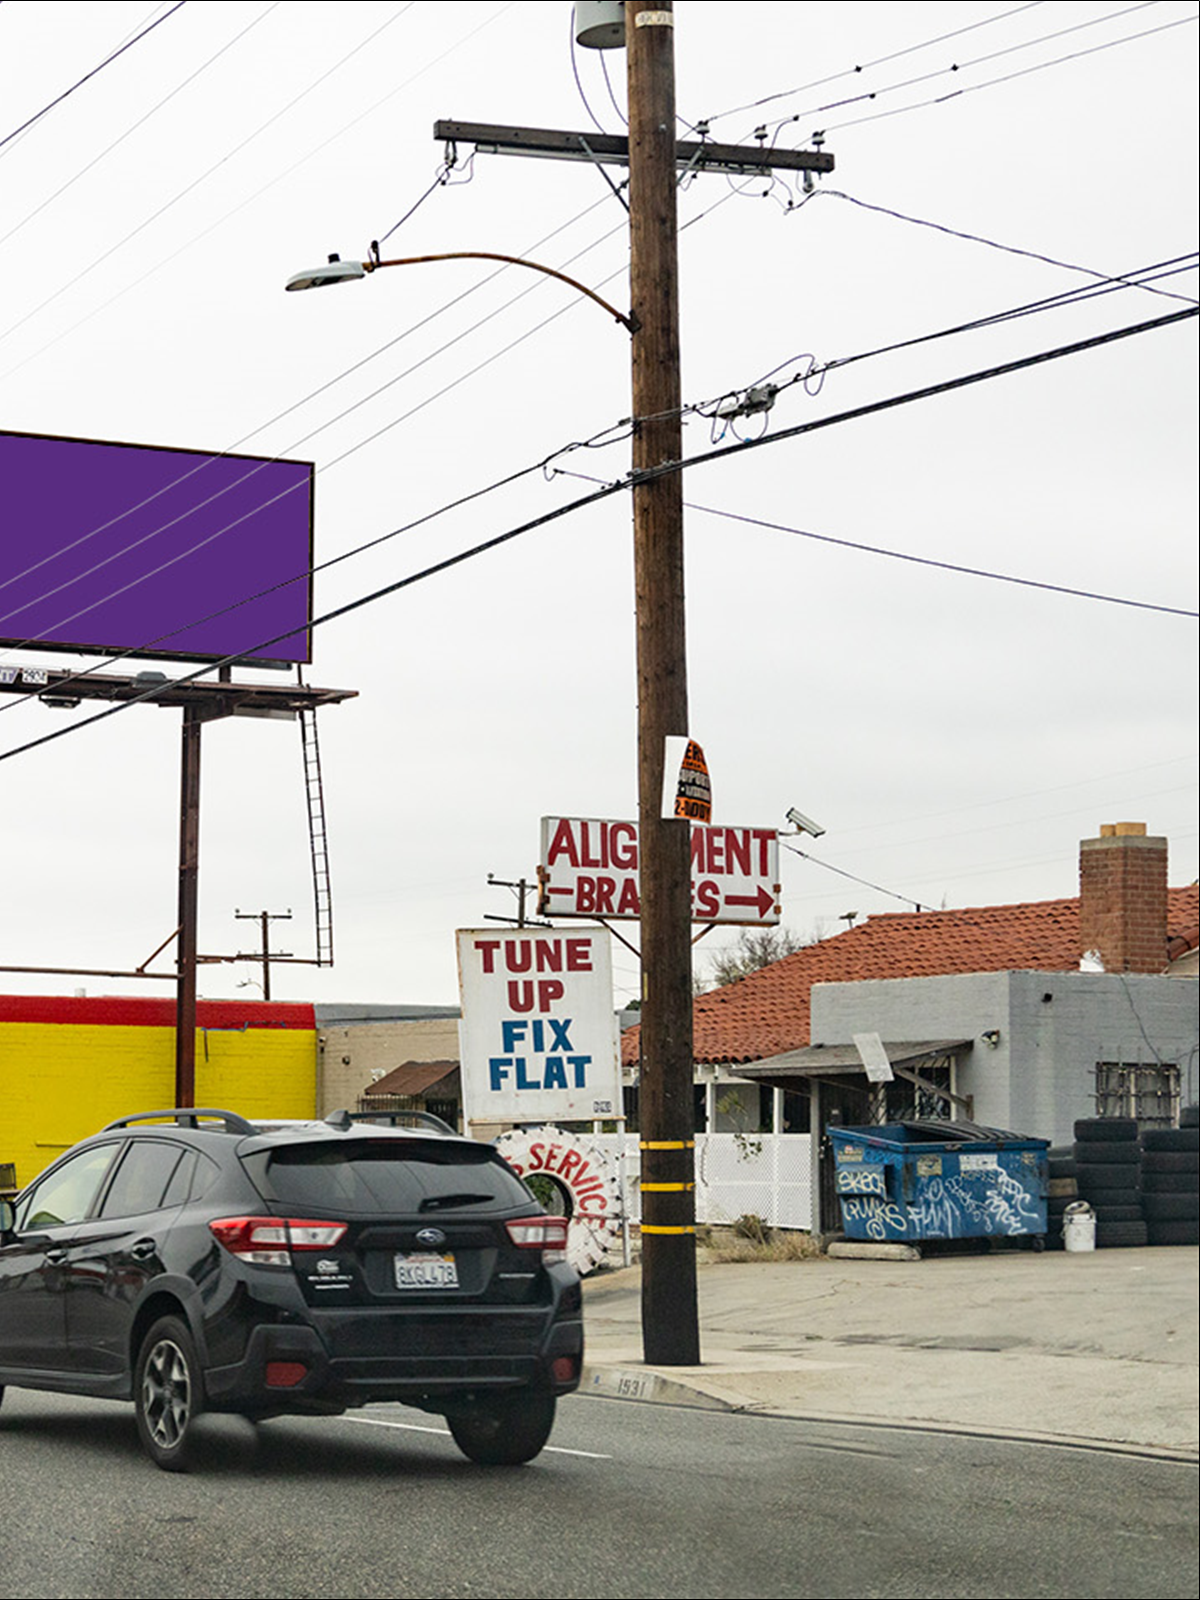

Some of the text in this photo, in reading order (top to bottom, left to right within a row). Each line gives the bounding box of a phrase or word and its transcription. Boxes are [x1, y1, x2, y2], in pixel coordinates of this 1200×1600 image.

[548, 818, 777, 877] ALIGENT
[576, 875, 720, 918] BRAS
[474, 938, 593, 974] TUNE
[506, 979, 565, 1013] UP
[501, 1018, 574, 1054] FIX
[489, 1055, 592, 1092] FLAT
[528, 1142, 608, 1230] SERVICE
